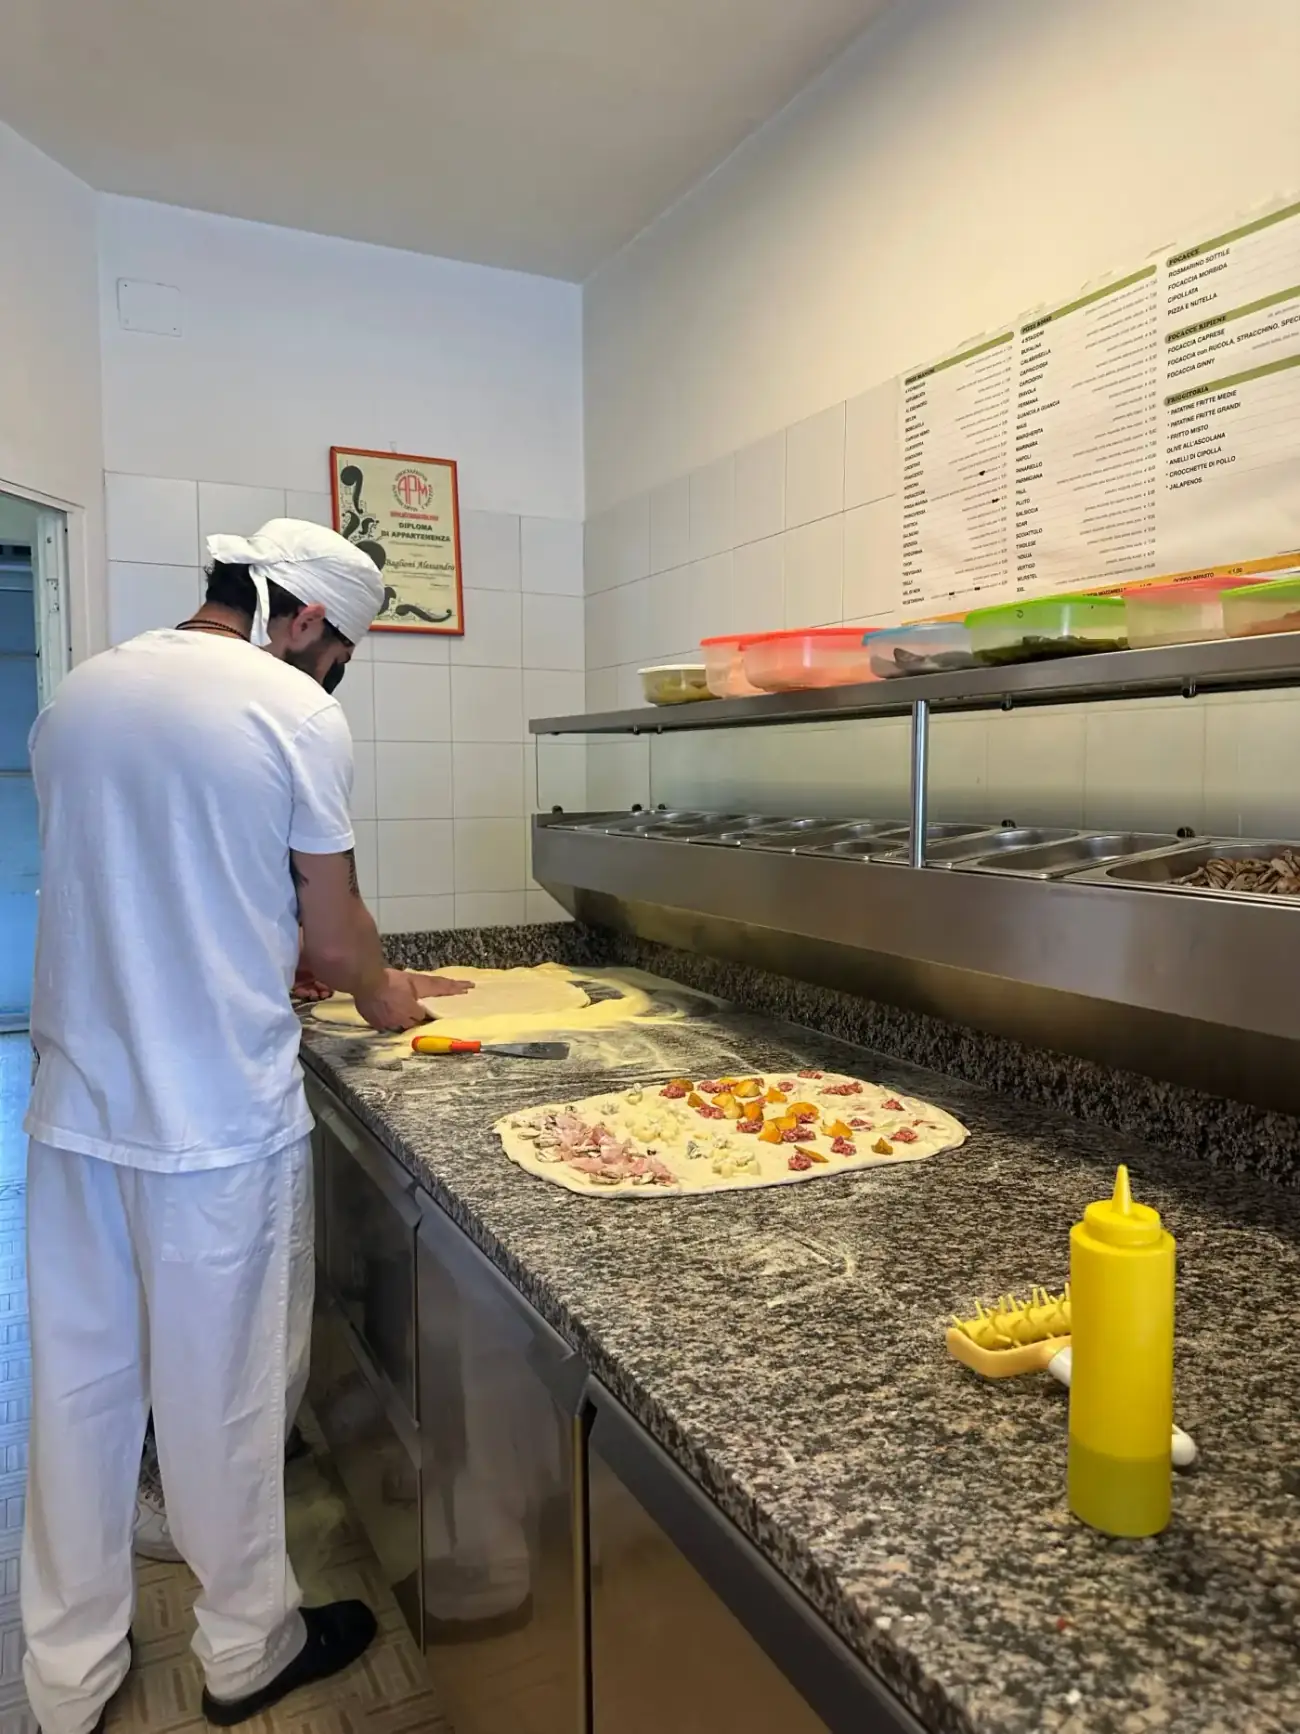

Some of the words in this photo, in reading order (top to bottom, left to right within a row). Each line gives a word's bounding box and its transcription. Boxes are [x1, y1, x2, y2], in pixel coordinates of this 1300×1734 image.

[1168, 259, 1205, 278] ROSMARINO
[1205, 248, 1231, 264] SOTTILE
[1167, 274, 1198, 291] FOCACCIA
[1198, 262, 1228, 279] MORBIDA
[1167, 286, 1199, 303] CIPOLLATA
[1167, 305, 1184, 316] PIZZA
[1190, 292, 1218, 307] NUTELLA
[1167, 339, 1196, 354] FOCACCIA
[1197, 328, 1225, 343] CAPRESE
[1167, 352, 1196, 367] FOCACCIA
[1196, 348, 1208, 356] con
[1208, 338, 1235, 352] RUCOLA,
[1236, 322, 1280, 343] STRACCHINO,
[1166, 364, 1196, 379] FOCACCIA
[1196, 357, 1216, 369] GINNY
[1018, 387, 1037, 398] DIAVOLA
[1170, 403, 1195, 415] PATATINE
[1196, 396, 1217, 407] FRITTE
[1217, 389, 1238, 401] MEDIE
[1170, 415, 1195, 428] PATATINE
[1195, 408, 1217, 420] FRITTE
[1216, 401, 1242, 414] GRANDI
[1170, 429, 1190, 440] FRITTO
[1190, 424, 1209, 434] MISTO
[1166, 444, 1182, 454] OLIVE
[1182, 432, 1226, 450] ALL'ASCOLANA
[1169, 454, 1189, 465] ANELLI
[1196, 446, 1222, 458] CIPOLLA
[1169, 462, 1208, 478] CROCCHETTE
[1208, 460, 1215, 468] DI
[1215, 455, 1237, 465] POLLO
[1169, 476, 1203, 490] JALAPENOS
[1015, 498, 1031, 506] PLUTO
[1015, 507, 1039, 517] SALSICCIA
[391, 531, 451, 542] APPARTENENZA
[398, 522, 433, 531] DIPLOMA
[416, 560, 455, 571] Alessandro
